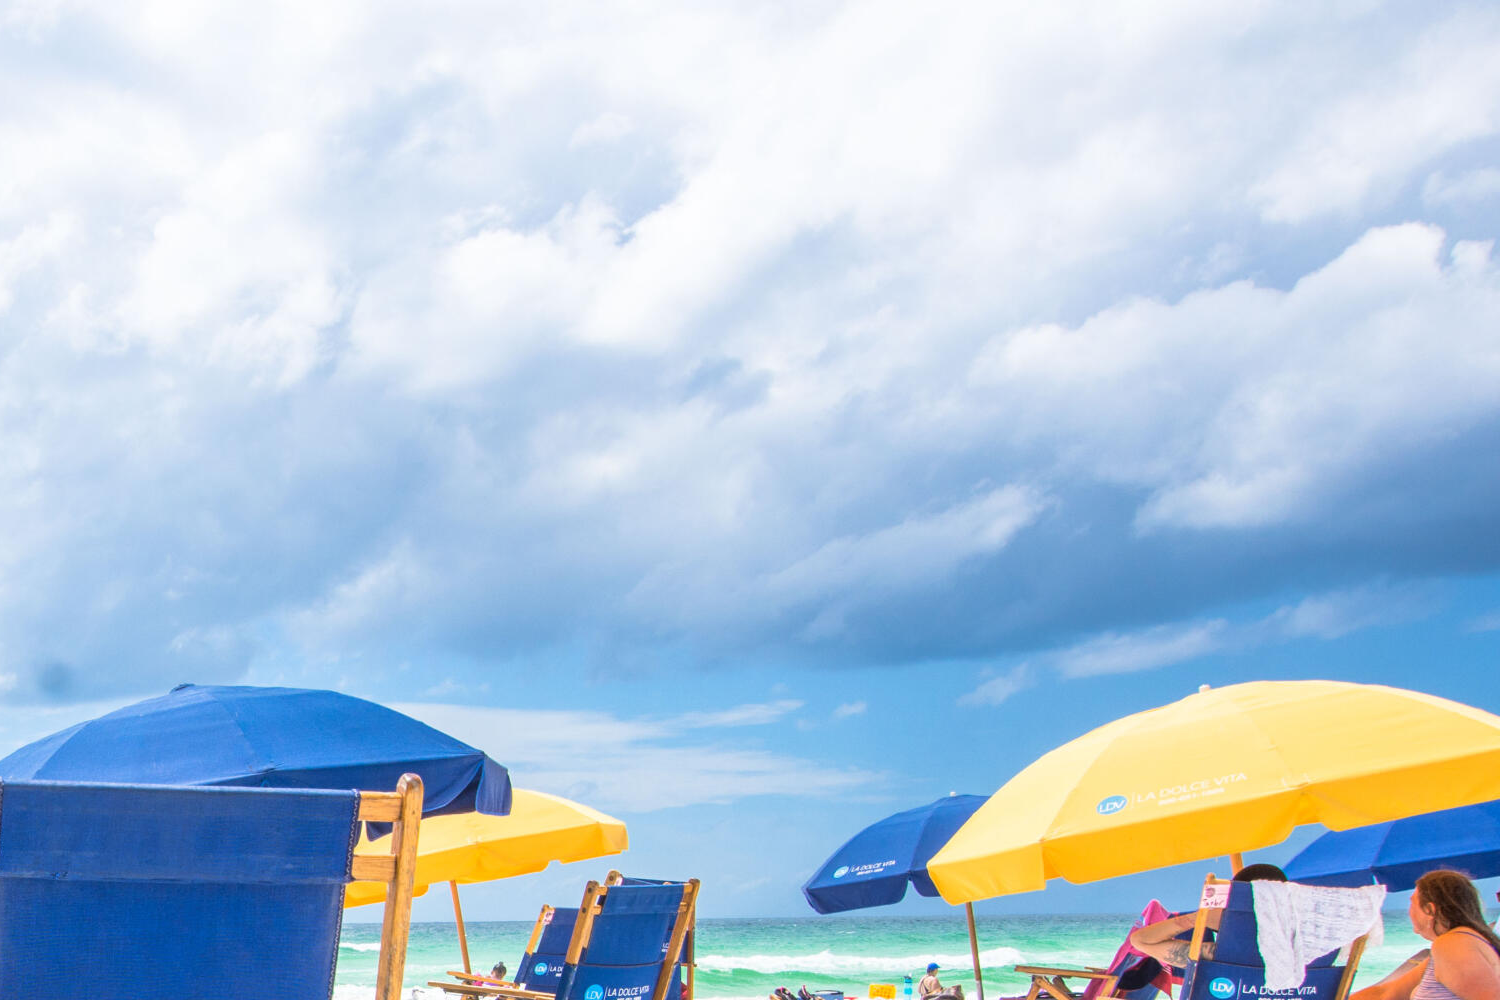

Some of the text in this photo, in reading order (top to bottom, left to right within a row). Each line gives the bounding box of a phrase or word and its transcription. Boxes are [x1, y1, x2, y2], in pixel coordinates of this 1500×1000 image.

[1214, 772, 1247, 786] VITA
[1099, 800, 1125, 813] LDV
[607, 988, 617, 997] LA
[1211, 982, 1235, 993] LDV
[1242, 984, 1257, 994] LA
[1296, 985, 1317, 996] VITA
[586, 990, 603, 1000] LDV
